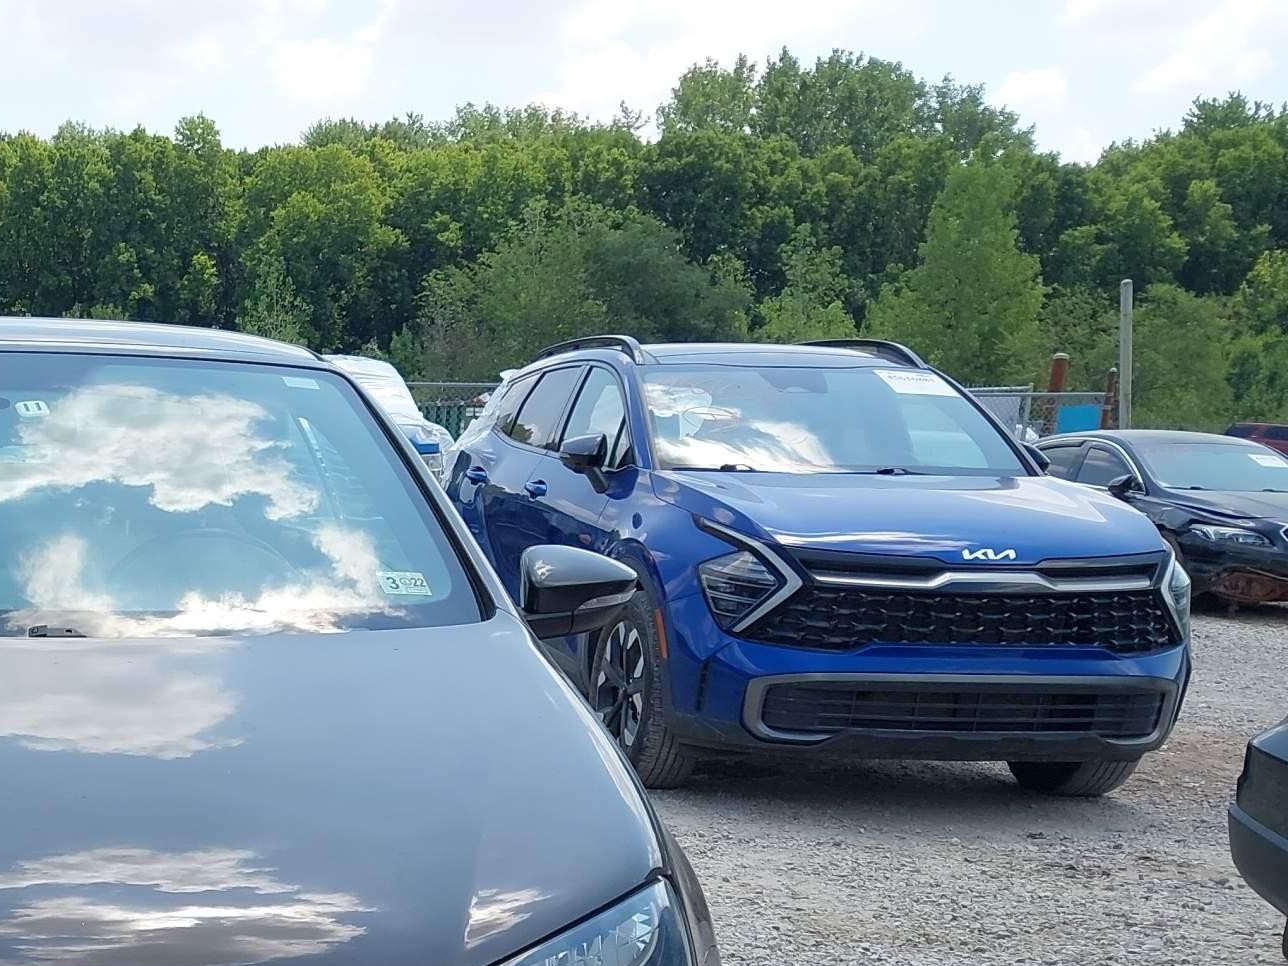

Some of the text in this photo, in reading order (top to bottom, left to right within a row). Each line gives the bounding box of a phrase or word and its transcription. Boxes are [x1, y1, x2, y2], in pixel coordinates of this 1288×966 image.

[962, 548, 1017, 561] KIA
[386, 576, 426, 589] 3 22
